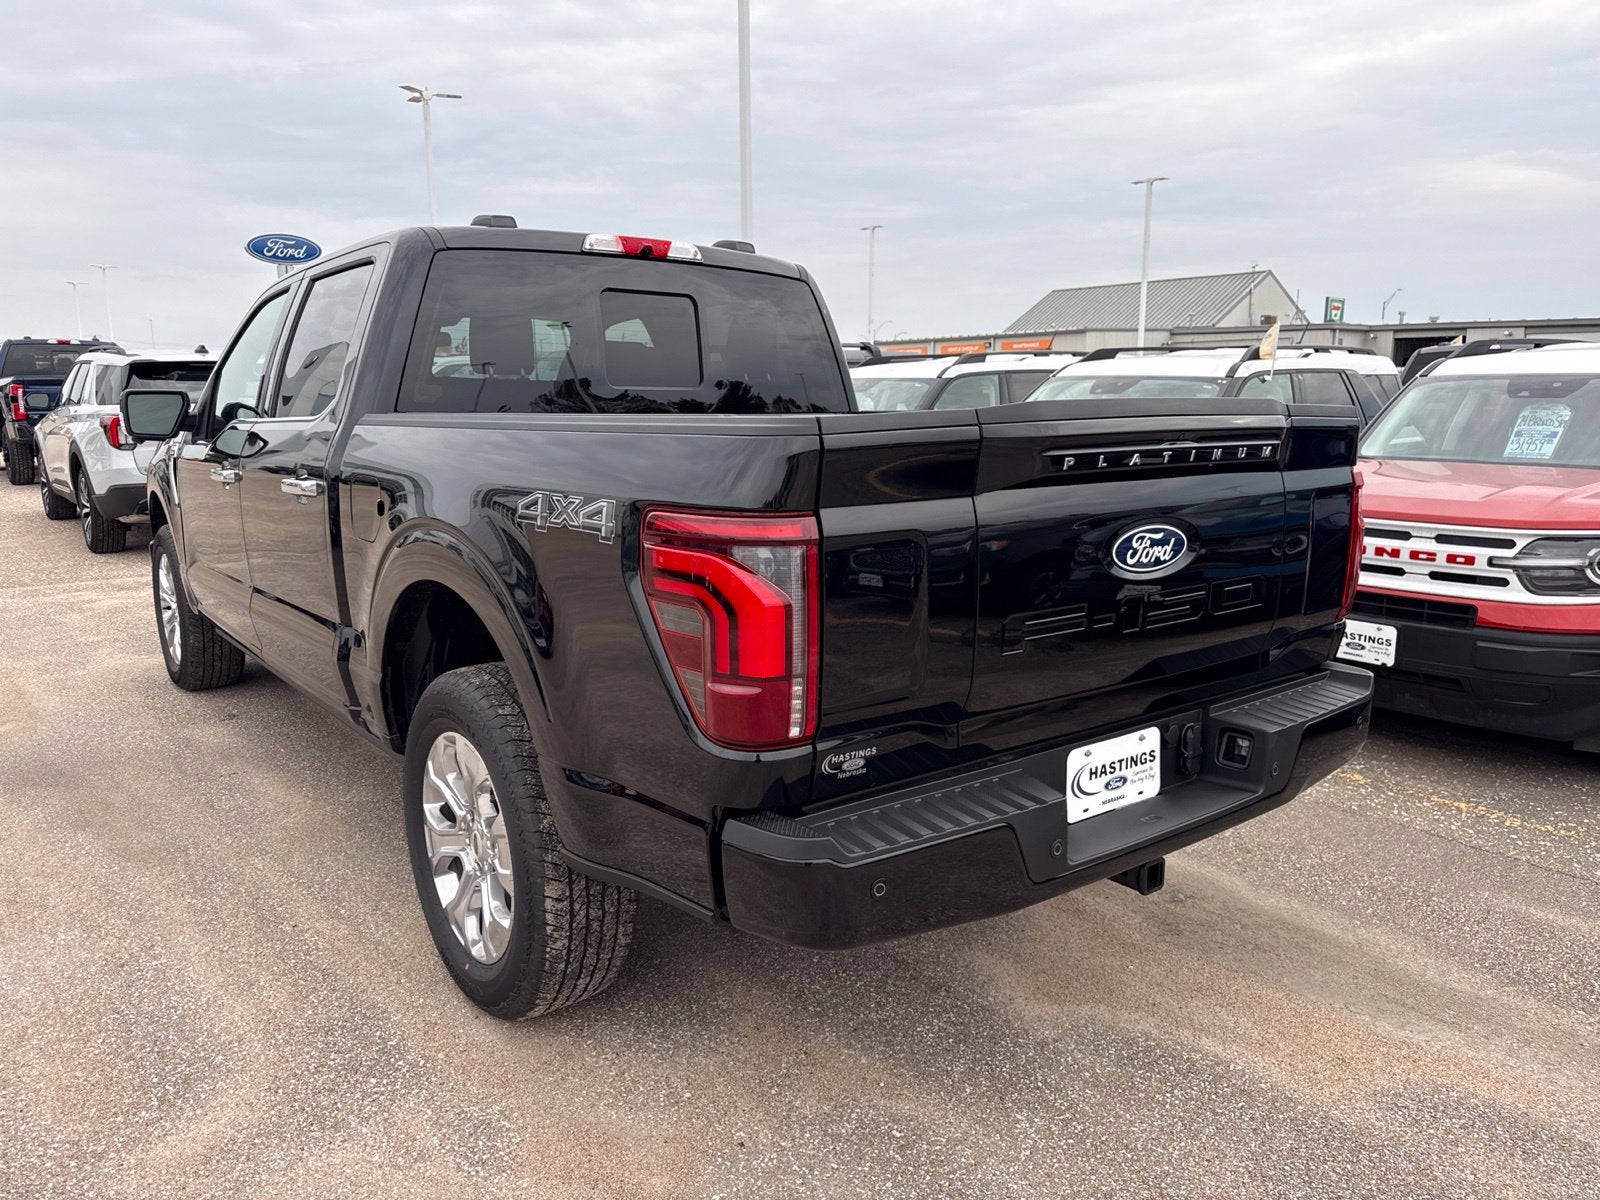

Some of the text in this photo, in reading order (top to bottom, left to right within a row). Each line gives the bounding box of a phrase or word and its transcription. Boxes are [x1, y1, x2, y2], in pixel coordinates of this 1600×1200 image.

[263, 238, 307, 259] Ford
[1062, 446, 1272, 471] PLATINUM
[1126, 531, 1174, 565] Ford
[1362, 545, 1476, 566] NCO
[1001, 573, 1267, 656] F-150
[831, 746, 877, 764] HASTINGS
[1089, 749, 1156, 781] HASTINGS
[837, 768, 867, 779] Nebraska
[1102, 794, 1125, 806] NEBRASKA
